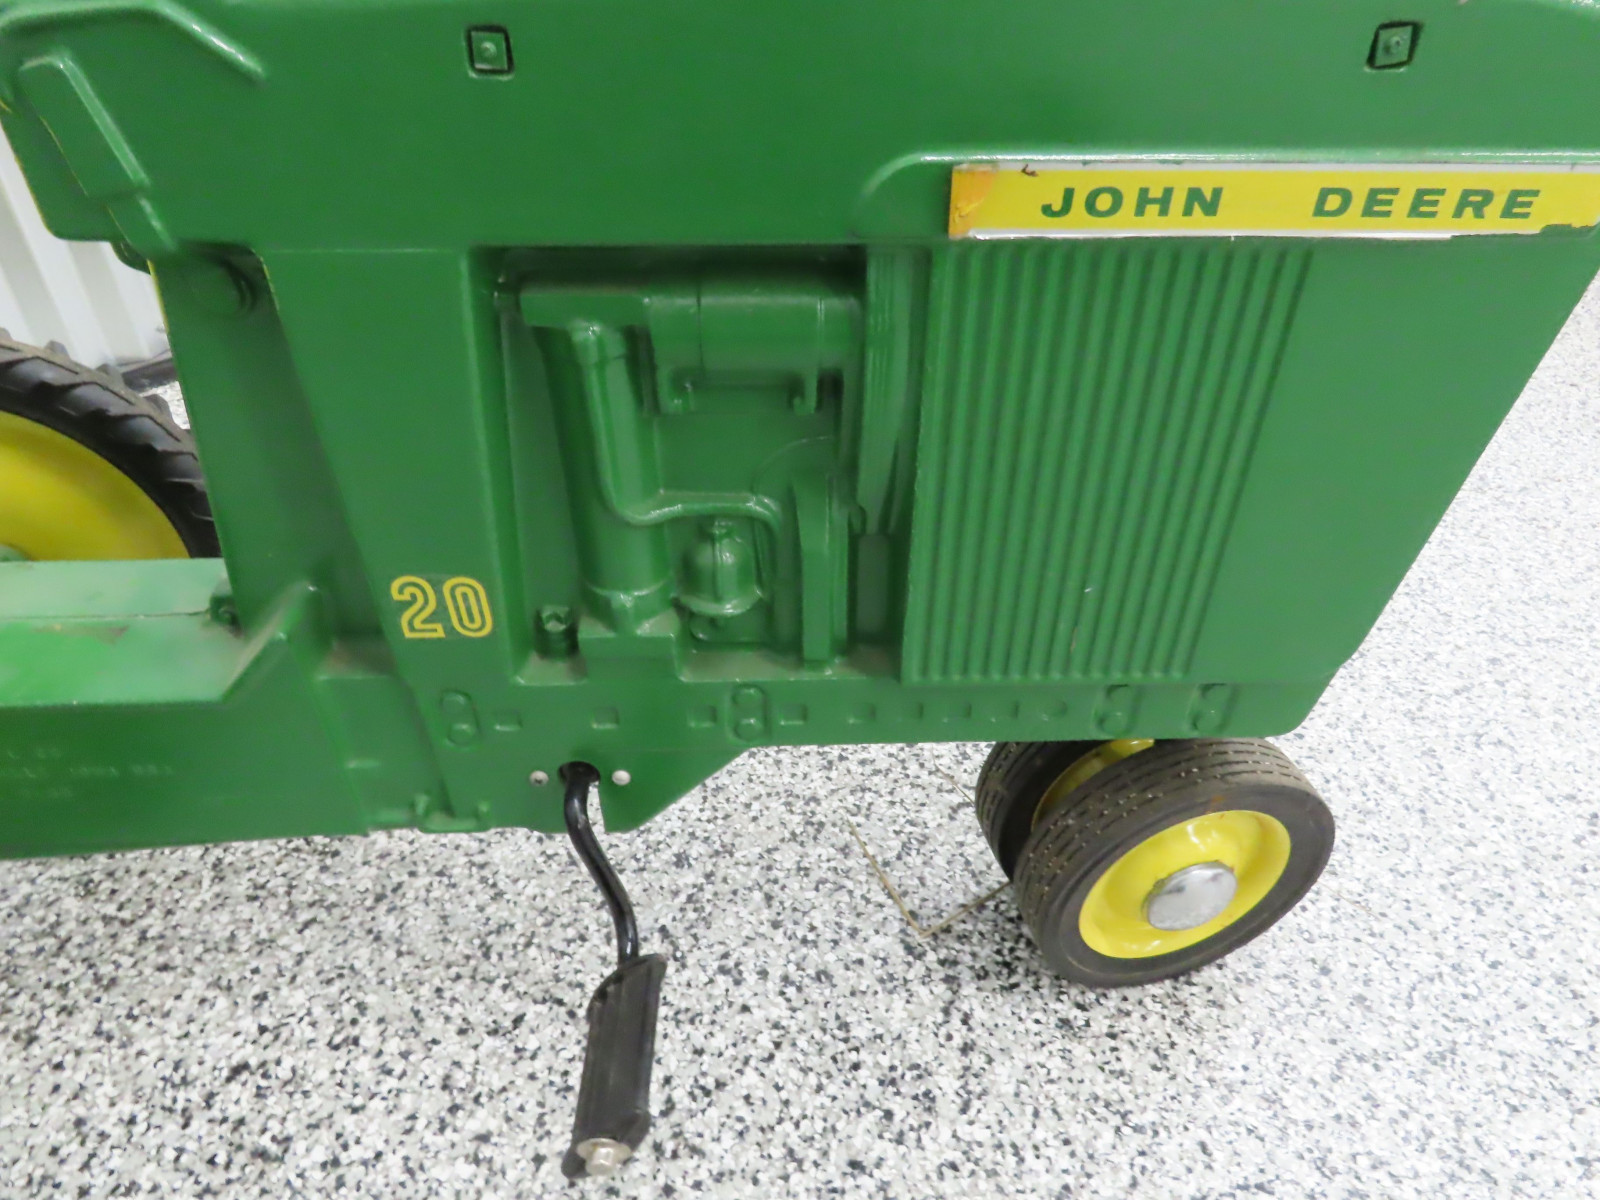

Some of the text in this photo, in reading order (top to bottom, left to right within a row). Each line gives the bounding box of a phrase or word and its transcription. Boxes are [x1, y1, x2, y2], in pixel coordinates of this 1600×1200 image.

[1042, 187, 1540, 218] JOHN DEERE
[391, 575, 493, 638] 20
